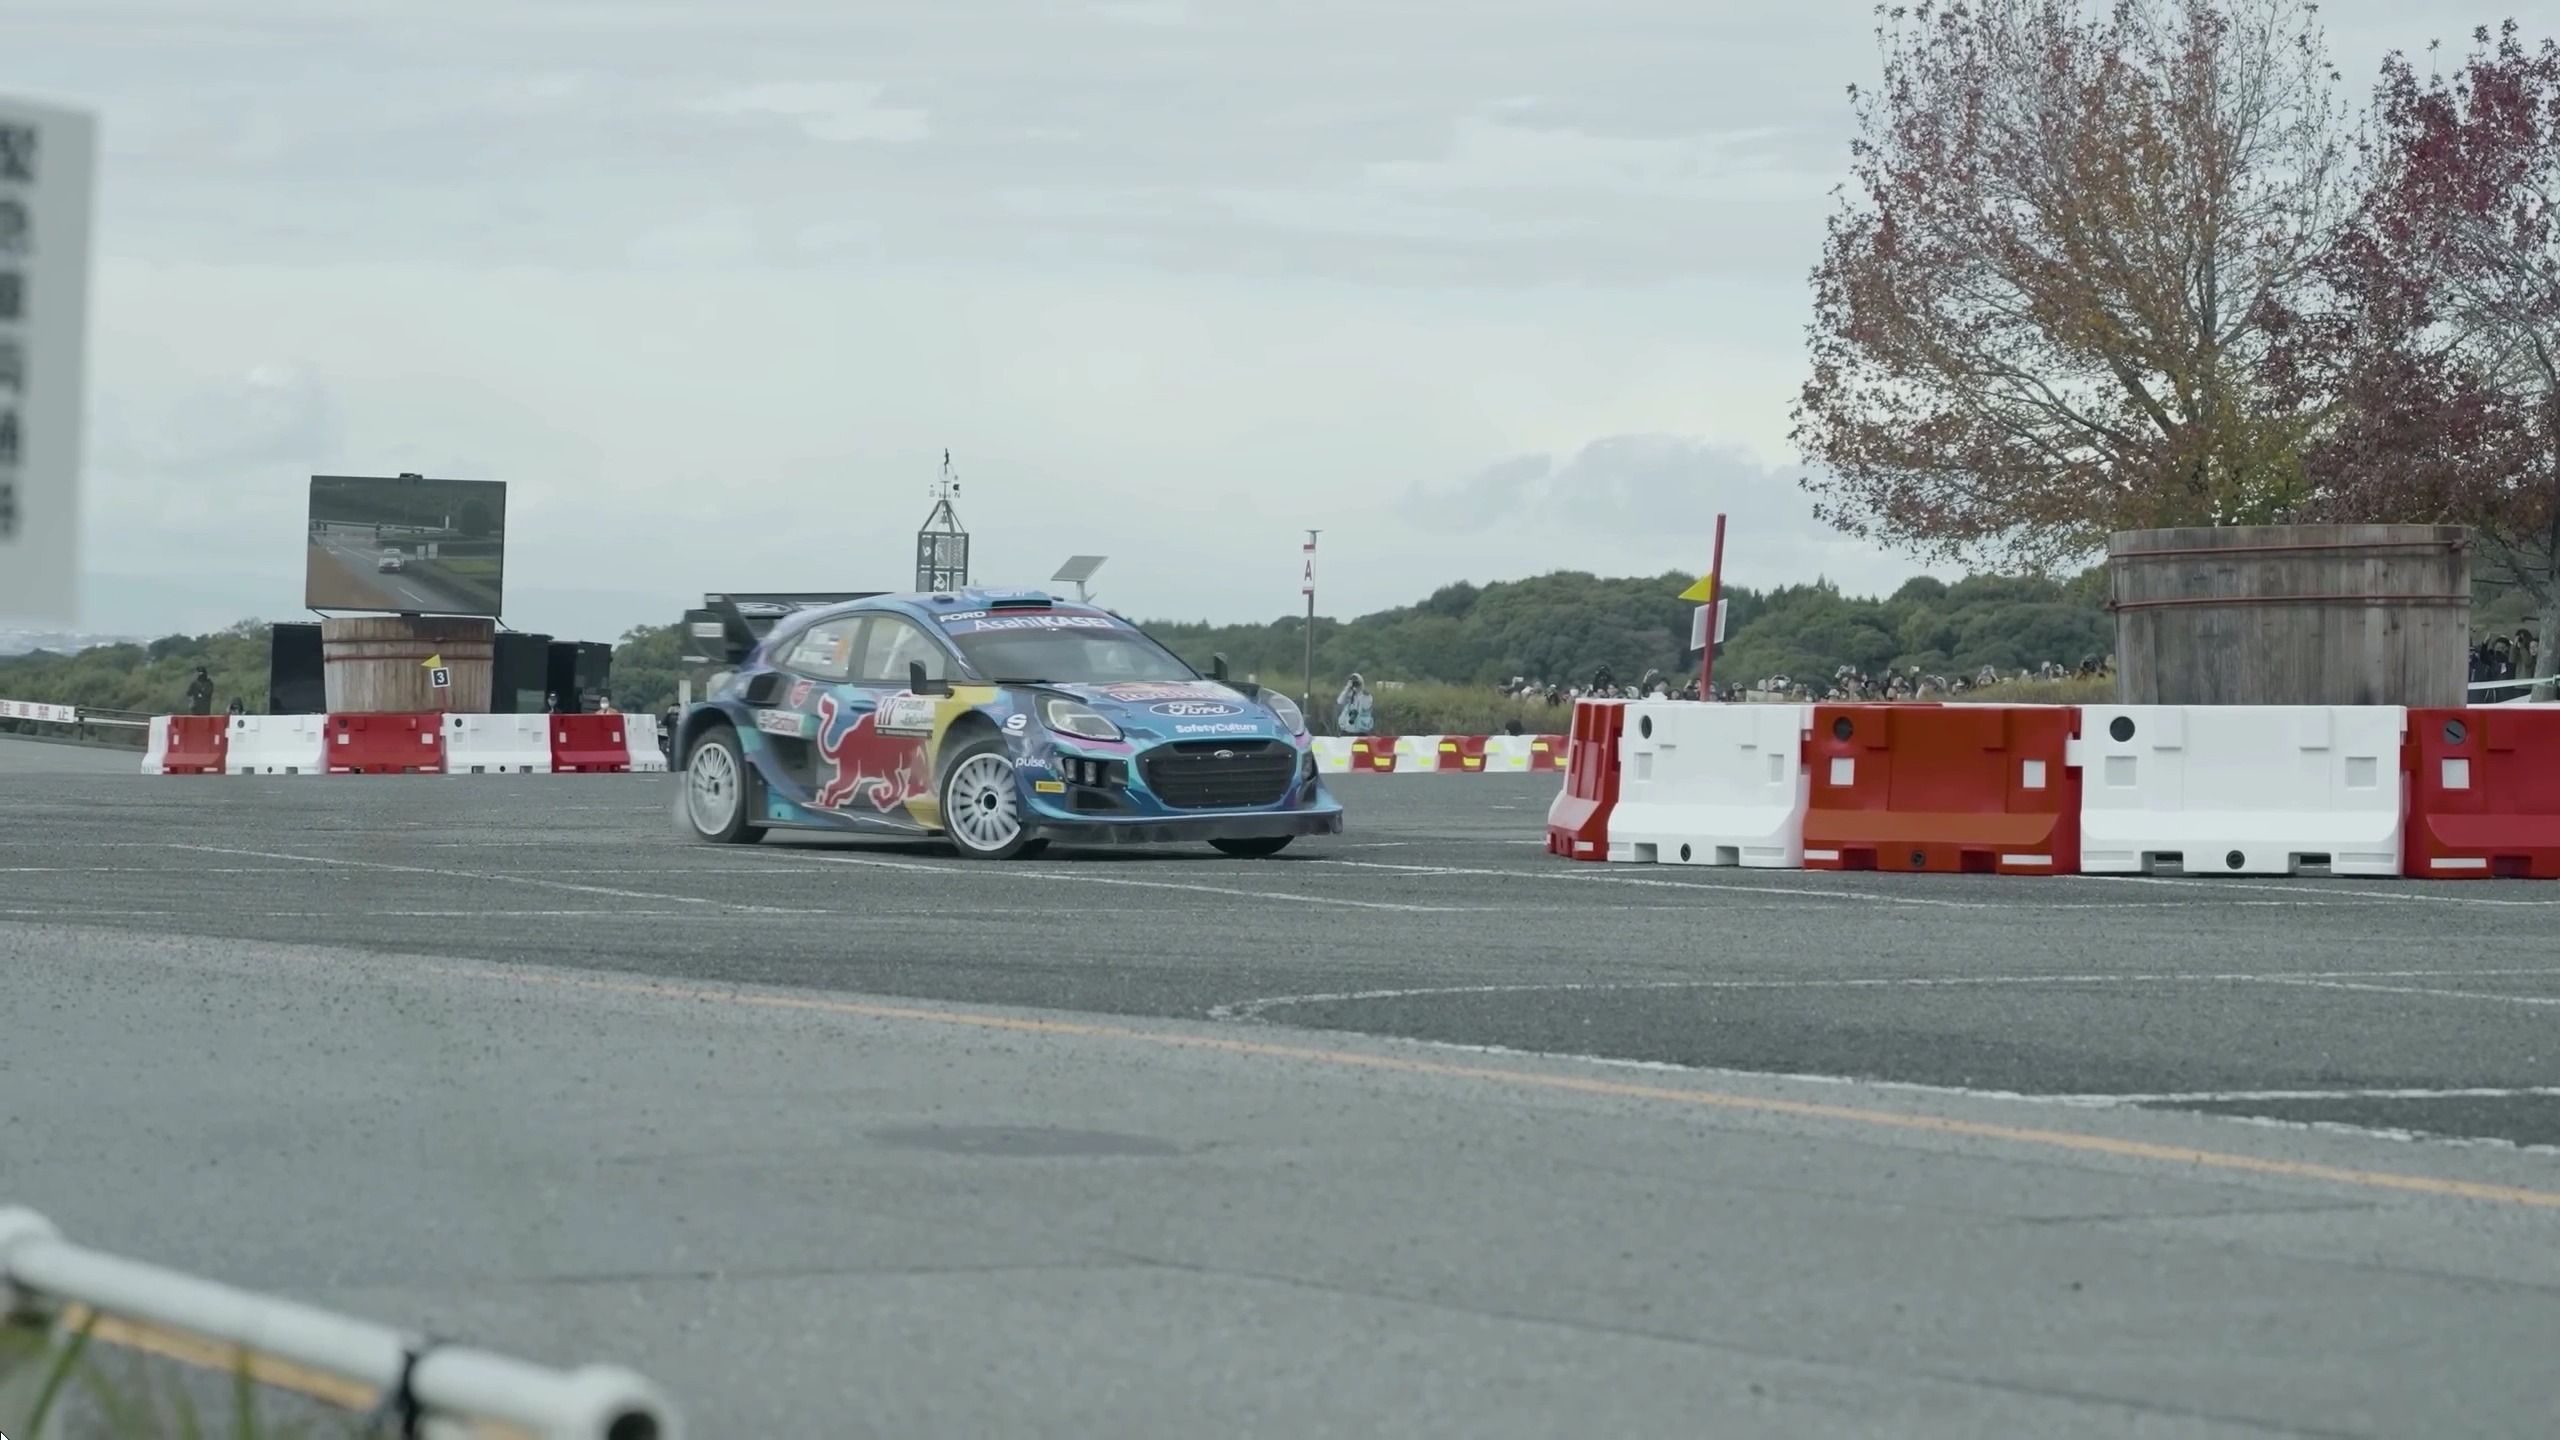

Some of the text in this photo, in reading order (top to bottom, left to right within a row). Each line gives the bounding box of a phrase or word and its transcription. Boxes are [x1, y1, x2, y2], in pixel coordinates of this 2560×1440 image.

[1304, 560, 1313, 581] A
[939, 611, 987, 622] FORD
[436, 671, 445, 683] 3
[1168, 702, 1229, 715] Ford
[1175, 723, 1258, 734] SafetyCulture
